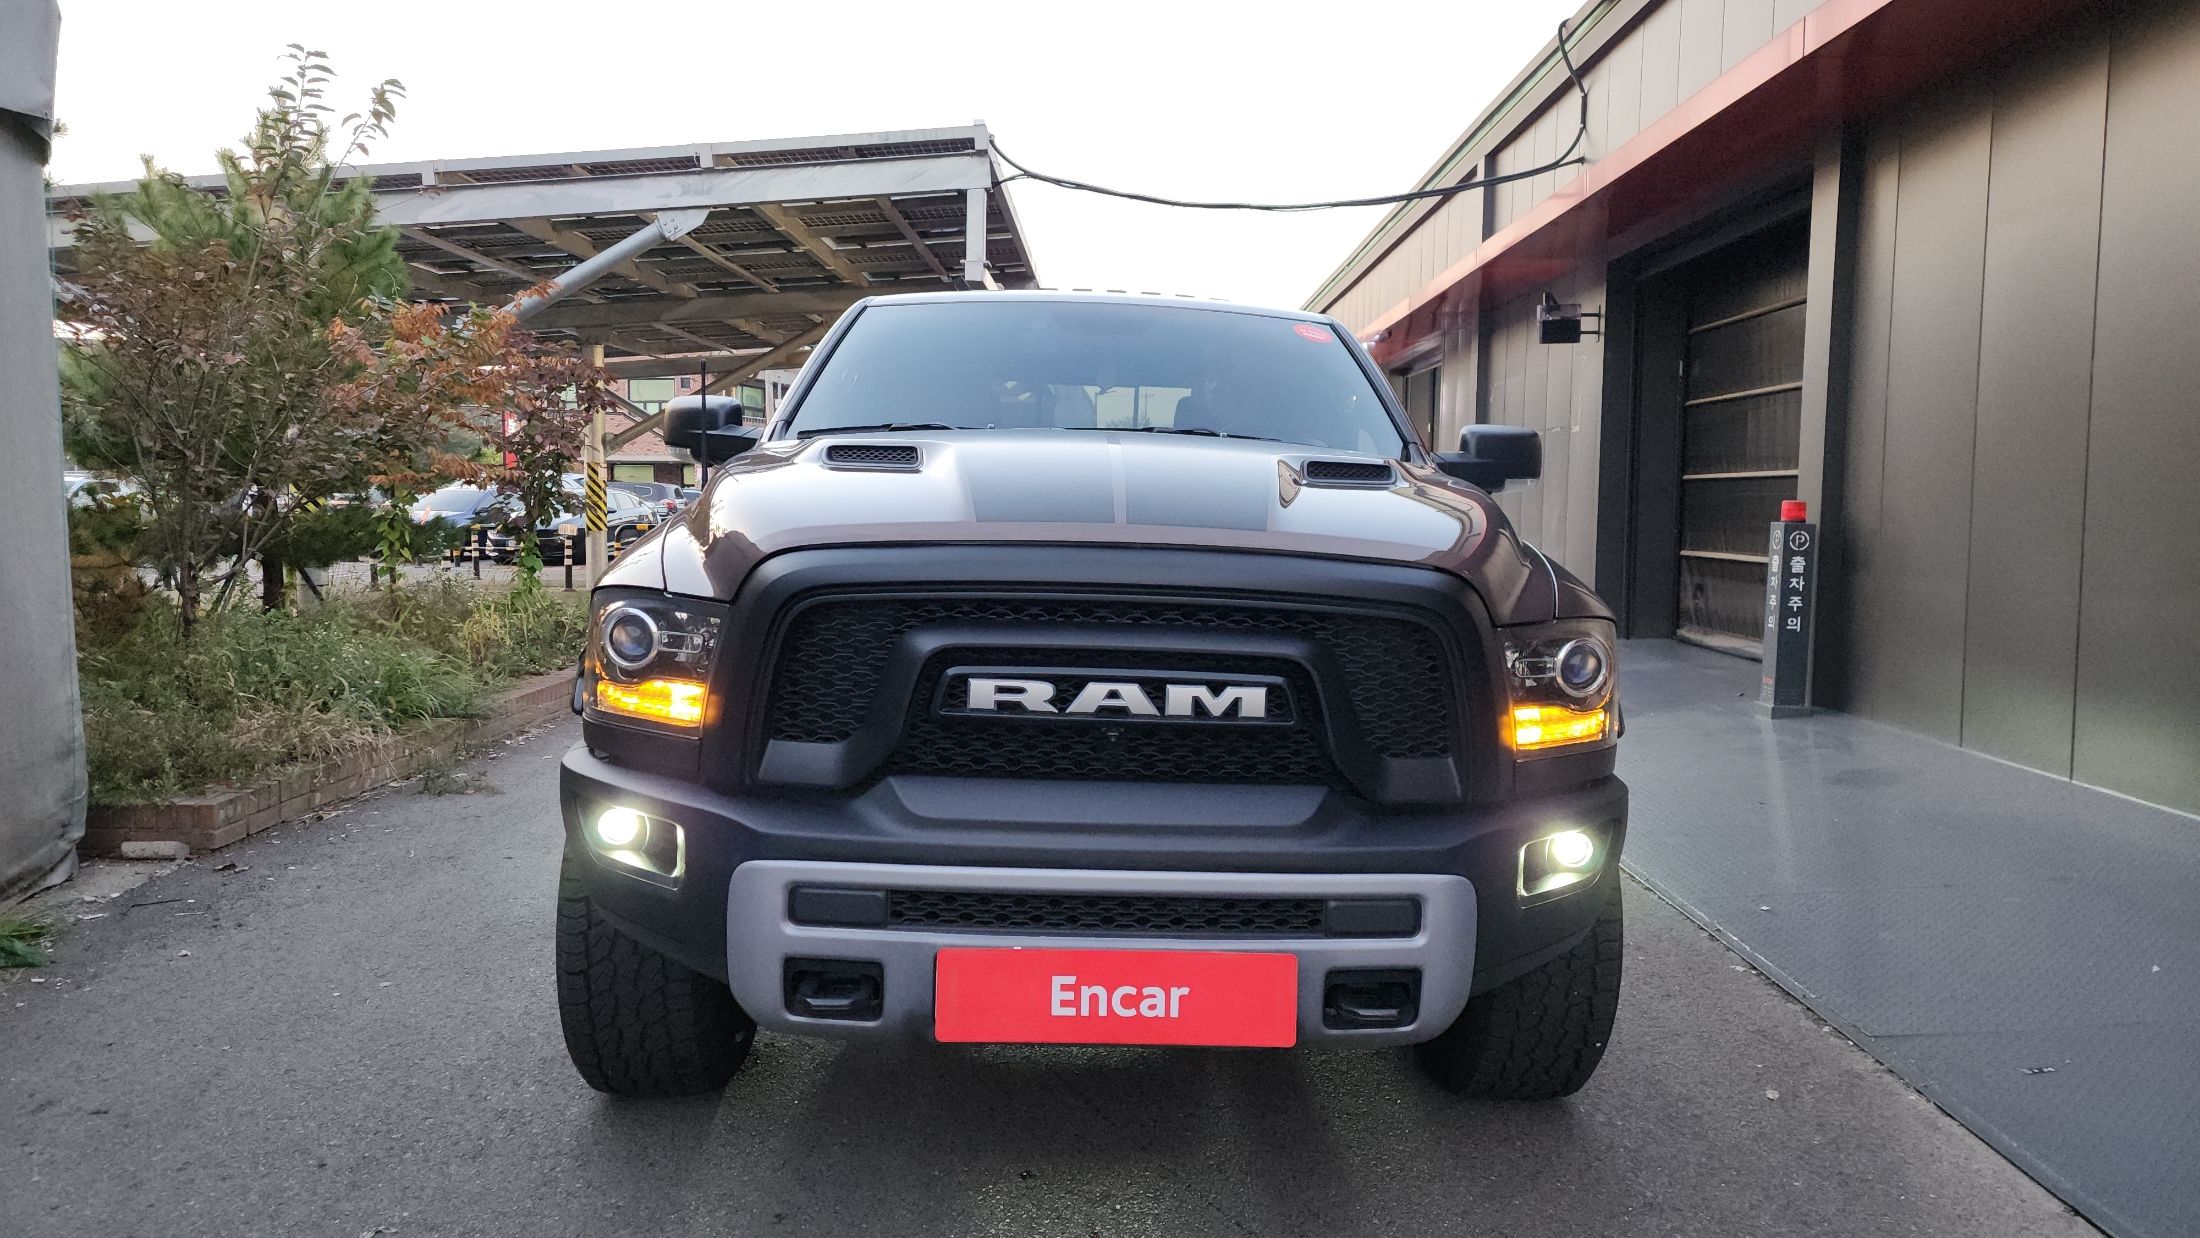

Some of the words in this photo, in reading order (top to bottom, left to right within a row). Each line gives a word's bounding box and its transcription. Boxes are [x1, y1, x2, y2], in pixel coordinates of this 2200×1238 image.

[1786, 555, 1806, 632] 출차주의
[967, 677, 1268, 718] RAM
[1051, 975, 1190, 1018] Encar
